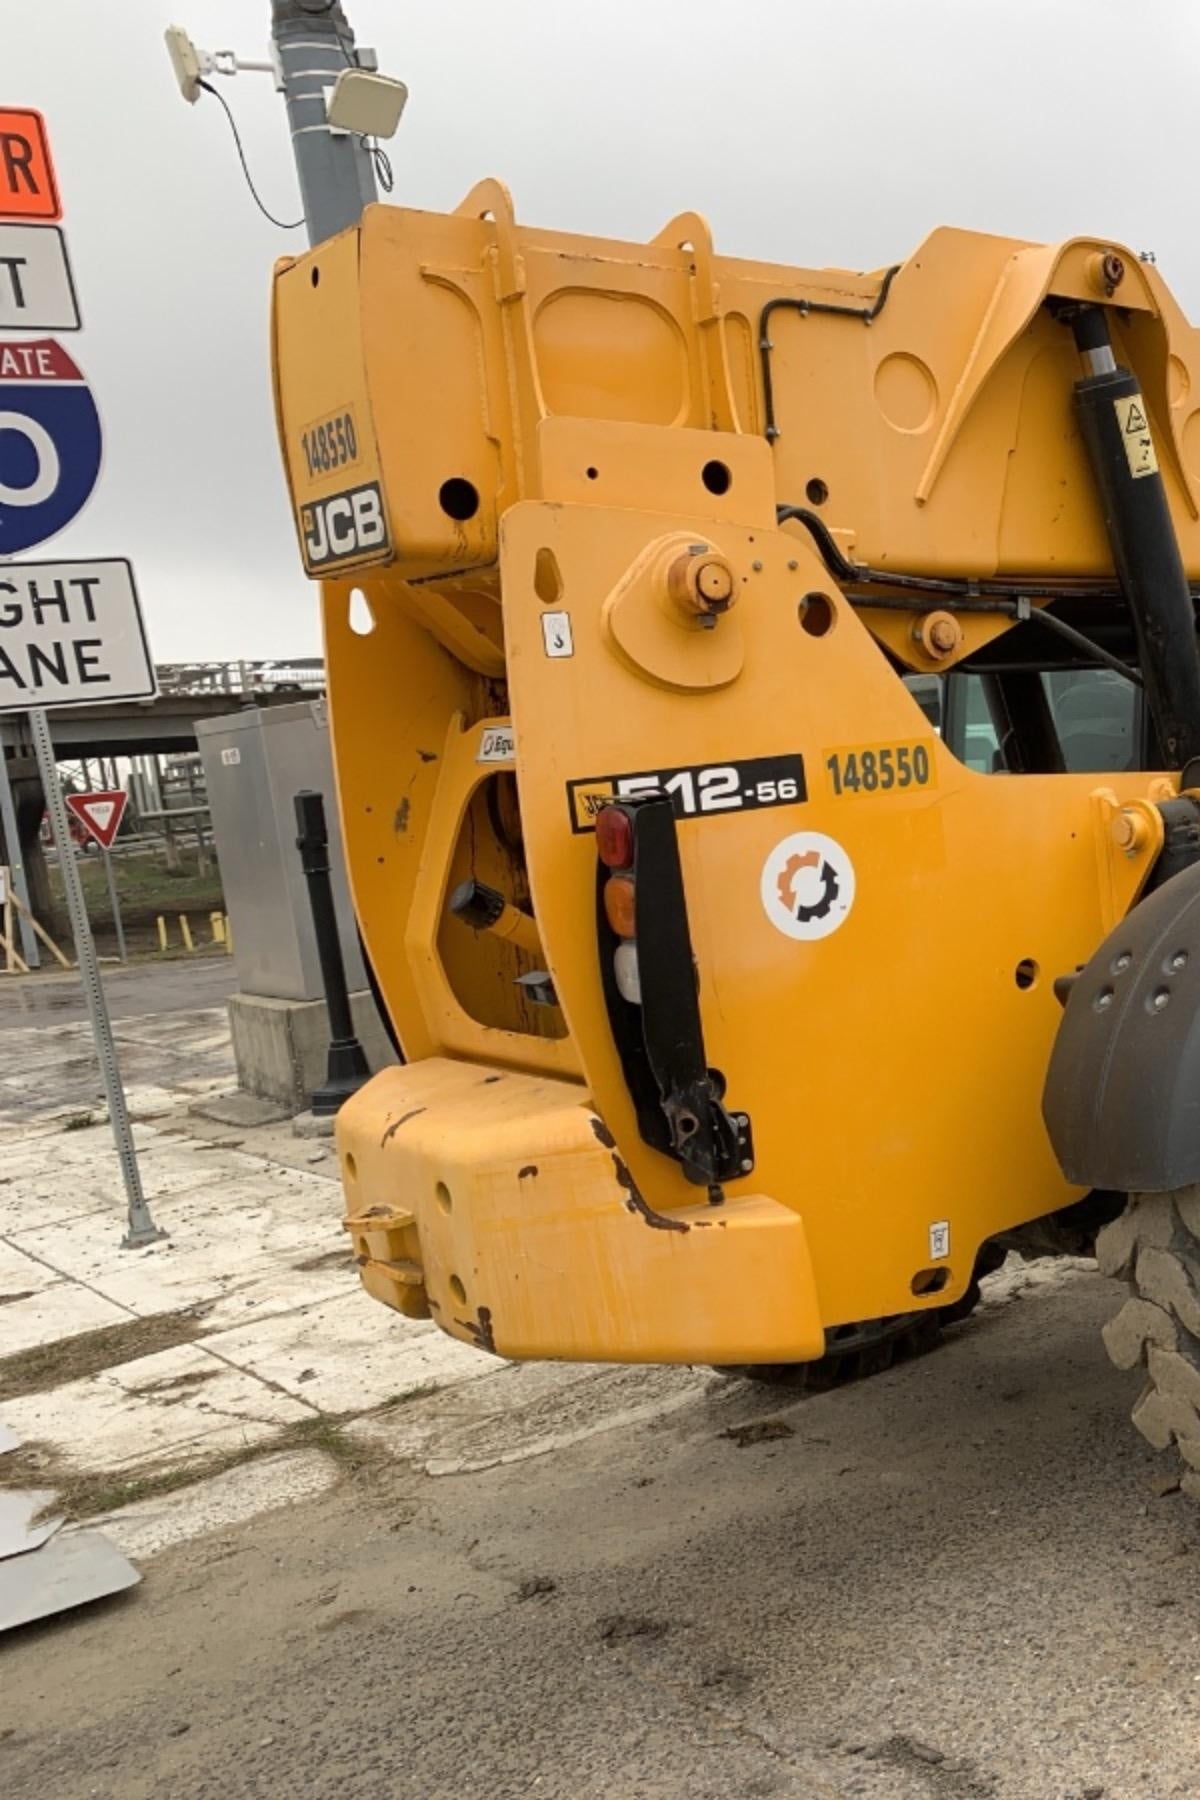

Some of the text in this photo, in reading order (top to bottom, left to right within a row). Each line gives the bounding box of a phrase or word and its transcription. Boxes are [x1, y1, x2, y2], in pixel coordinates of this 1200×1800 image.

[302, 413, 357, 478] 148550
[307, 489, 385, 561] JCB
[827, 745, 929, 795] 148550
